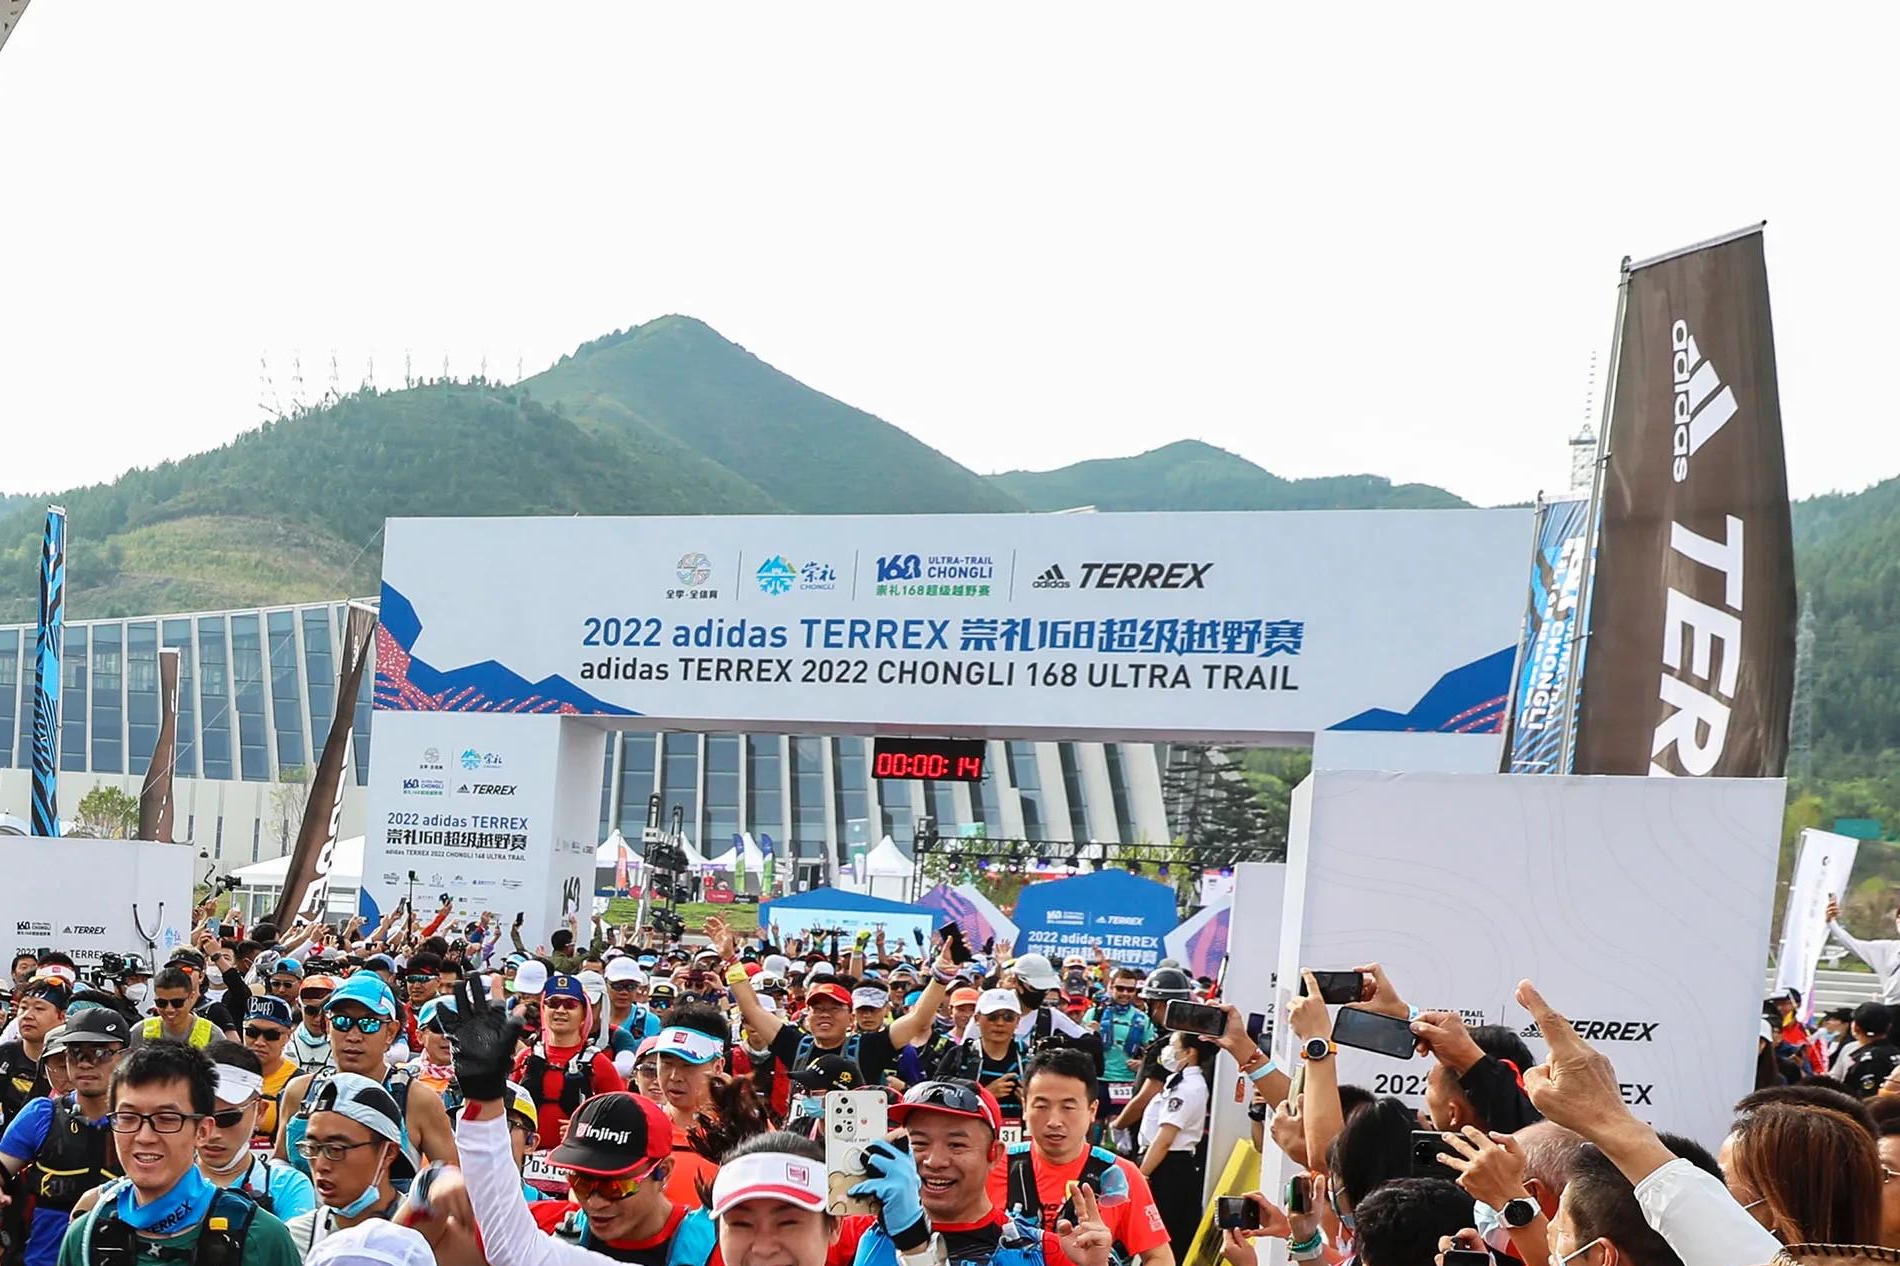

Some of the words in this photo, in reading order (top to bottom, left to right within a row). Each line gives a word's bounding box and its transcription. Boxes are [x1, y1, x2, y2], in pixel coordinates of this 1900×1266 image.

[1672, 318, 1689, 485] adidas
[928, 556, 993, 565] ULTRA-TRAIL
[927, 566, 993, 579] CHONGLI
[1032, 580, 1070, 589] adidas
[1079, 562, 1214, 589] TERREX
[583, 617, 662, 647] 2022
[672, 618, 788, 649] adidas
[800, 618, 950, 650] TERREX
[960, 618, 1304, 657] 崇礼168超级越野赛
[1648, 514, 1744, 777] TER
[580, 657, 669, 681] adidas
[678, 658, 794, 683] TERREX
[801, 660, 868, 684] 2022
[878, 660, 1014, 686] CHONGLI
[1027, 663, 1077, 687] 168
[1088, 663, 1191, 689] ULTRA
[1202, 665, 1299, 690] TRAIL
[1528, 621, 1565, 731] CHONGLI
[472, 784, 518, 795] TERREX
[388, 813, 419, 825] 2022
[422, 814, 467, 828] adidas
[472, 816, 528, 830] TERREX
[73, 926, 106, 935] TERREX
[1028, 931, 1058, 943] 2022
[1061, 933, 1102, 945] adidas
[1106, 934, 1159, 948] TERREX
